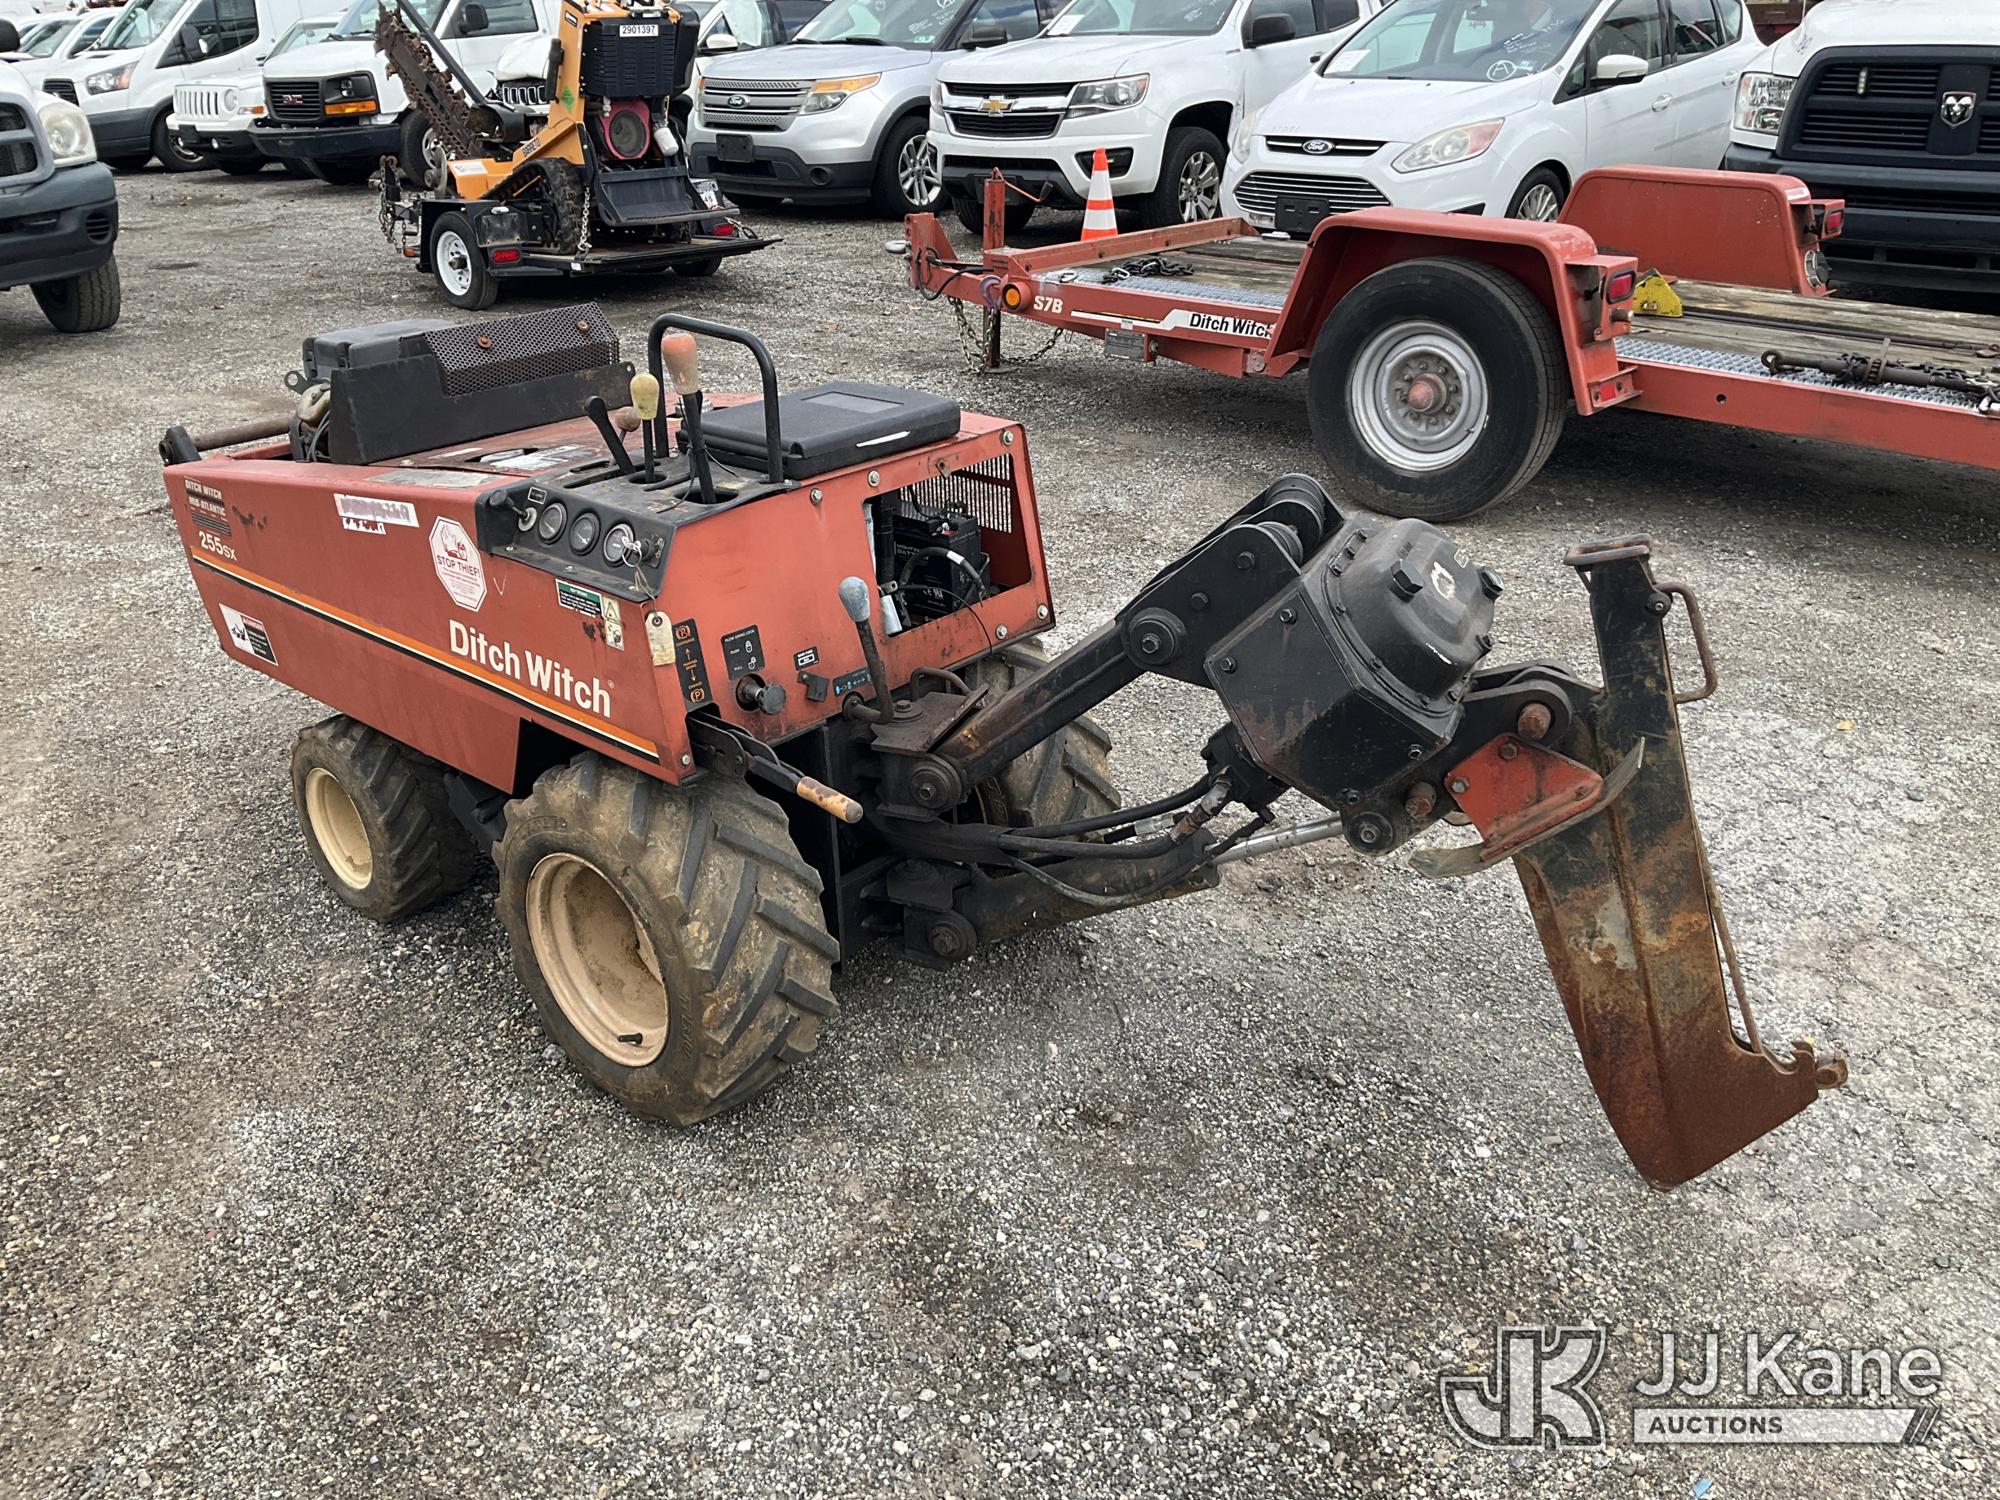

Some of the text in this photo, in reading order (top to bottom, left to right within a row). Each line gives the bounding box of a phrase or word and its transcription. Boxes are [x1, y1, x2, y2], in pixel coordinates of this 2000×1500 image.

[622, 25, 656, 34] 2901397
[1033, 295, 1064, 314] S7B
[1190, 313, 1229, 331] Ditch
[437, 554, 481, 578] STOP THIEF!
[449, 619, 611, 718] Ditch Witch
